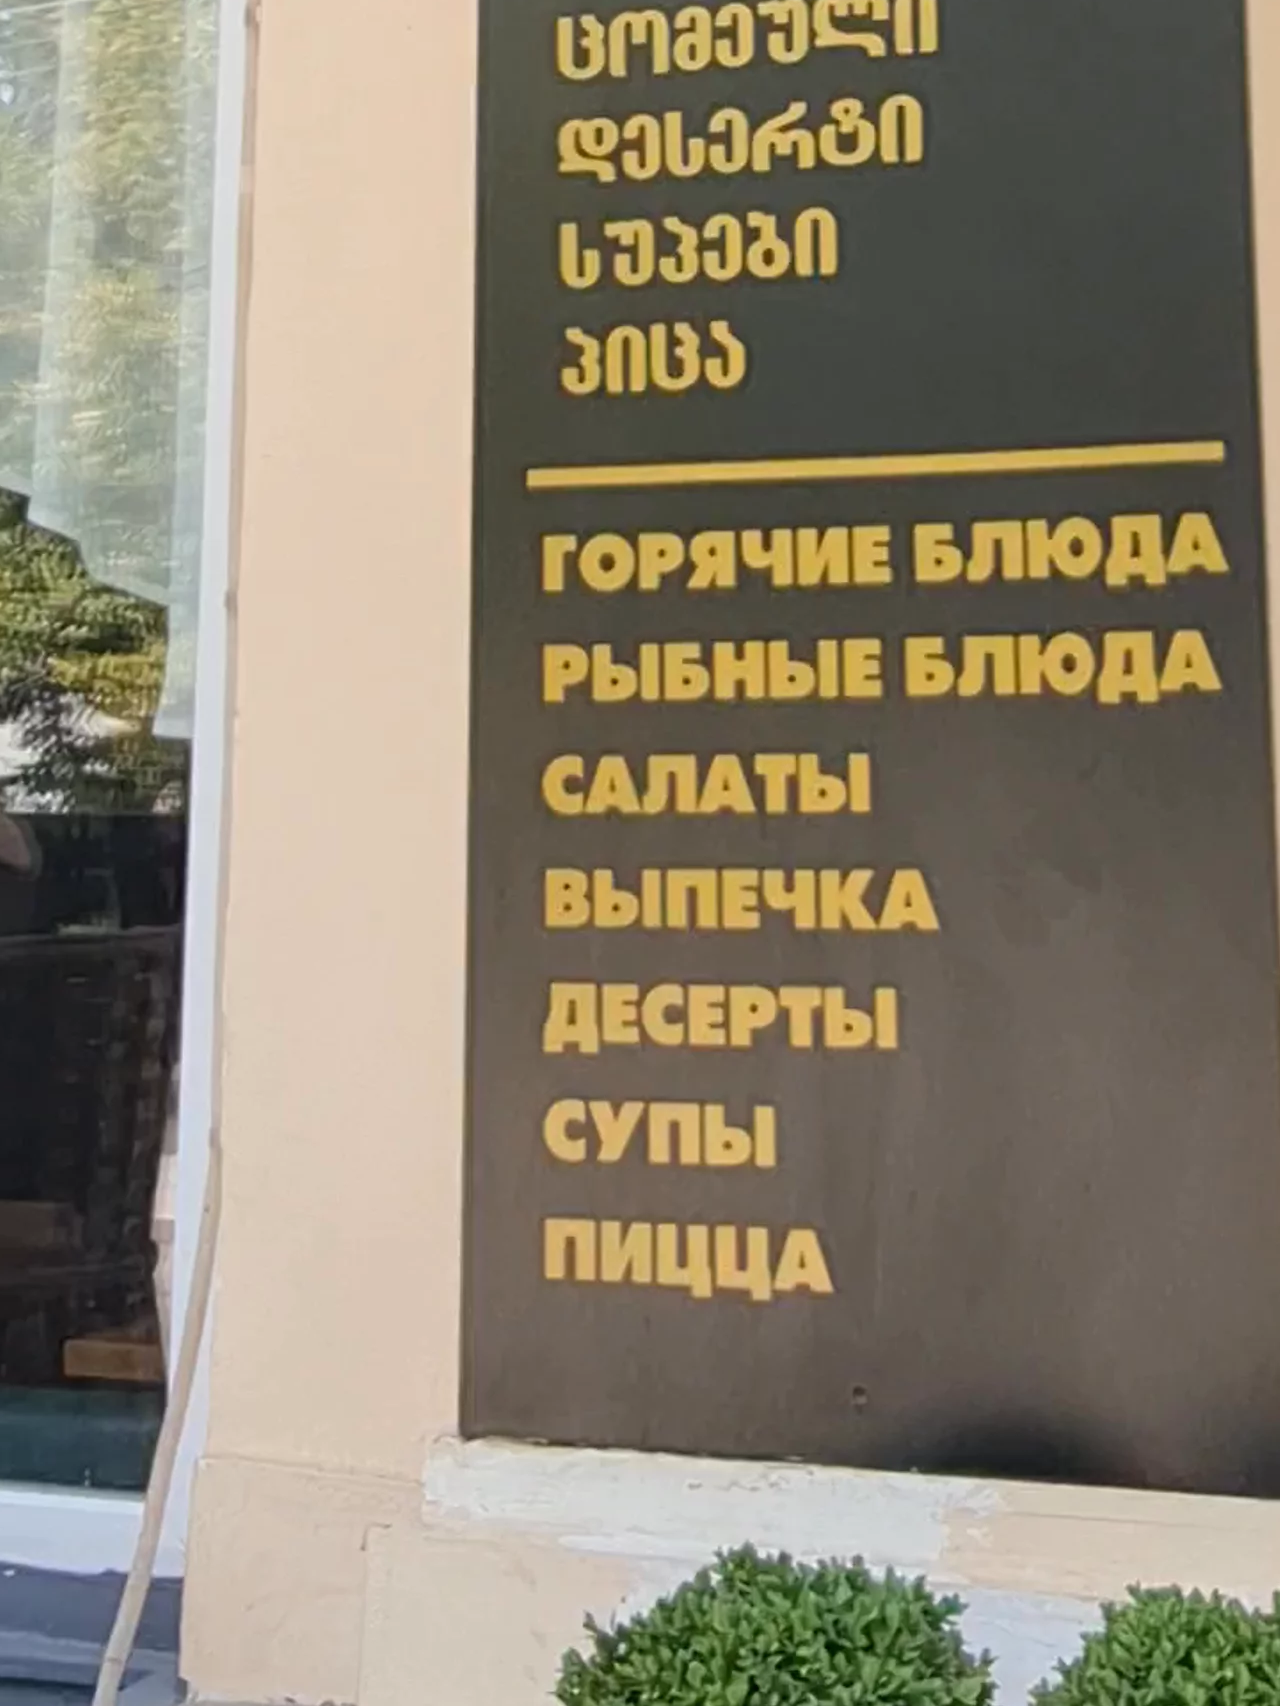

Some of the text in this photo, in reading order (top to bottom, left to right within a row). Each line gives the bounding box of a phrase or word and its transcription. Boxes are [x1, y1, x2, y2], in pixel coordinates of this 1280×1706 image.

[557, 94, 925, 183] დესერტი
[558, 206, 839, 290] სუპები
[560, 320, 747, 396] პიცა
[541, 512, 1229, 593] ГОРЯЧИЕ БЛЮДА
[542, 629, 1224, 704] РЫБНЫЕ БЛЮДА
[541, 752, 872, 817] САЛАТЫ
[543, 867, 940, 934] ВЫПЕЧКА
[541, 981, 900, 1058] ДЕСЕРТЫ
[542, 1098, 778, 1171] СУПЫ
[542, 1216, 834, 1305] ПИЦЦА
